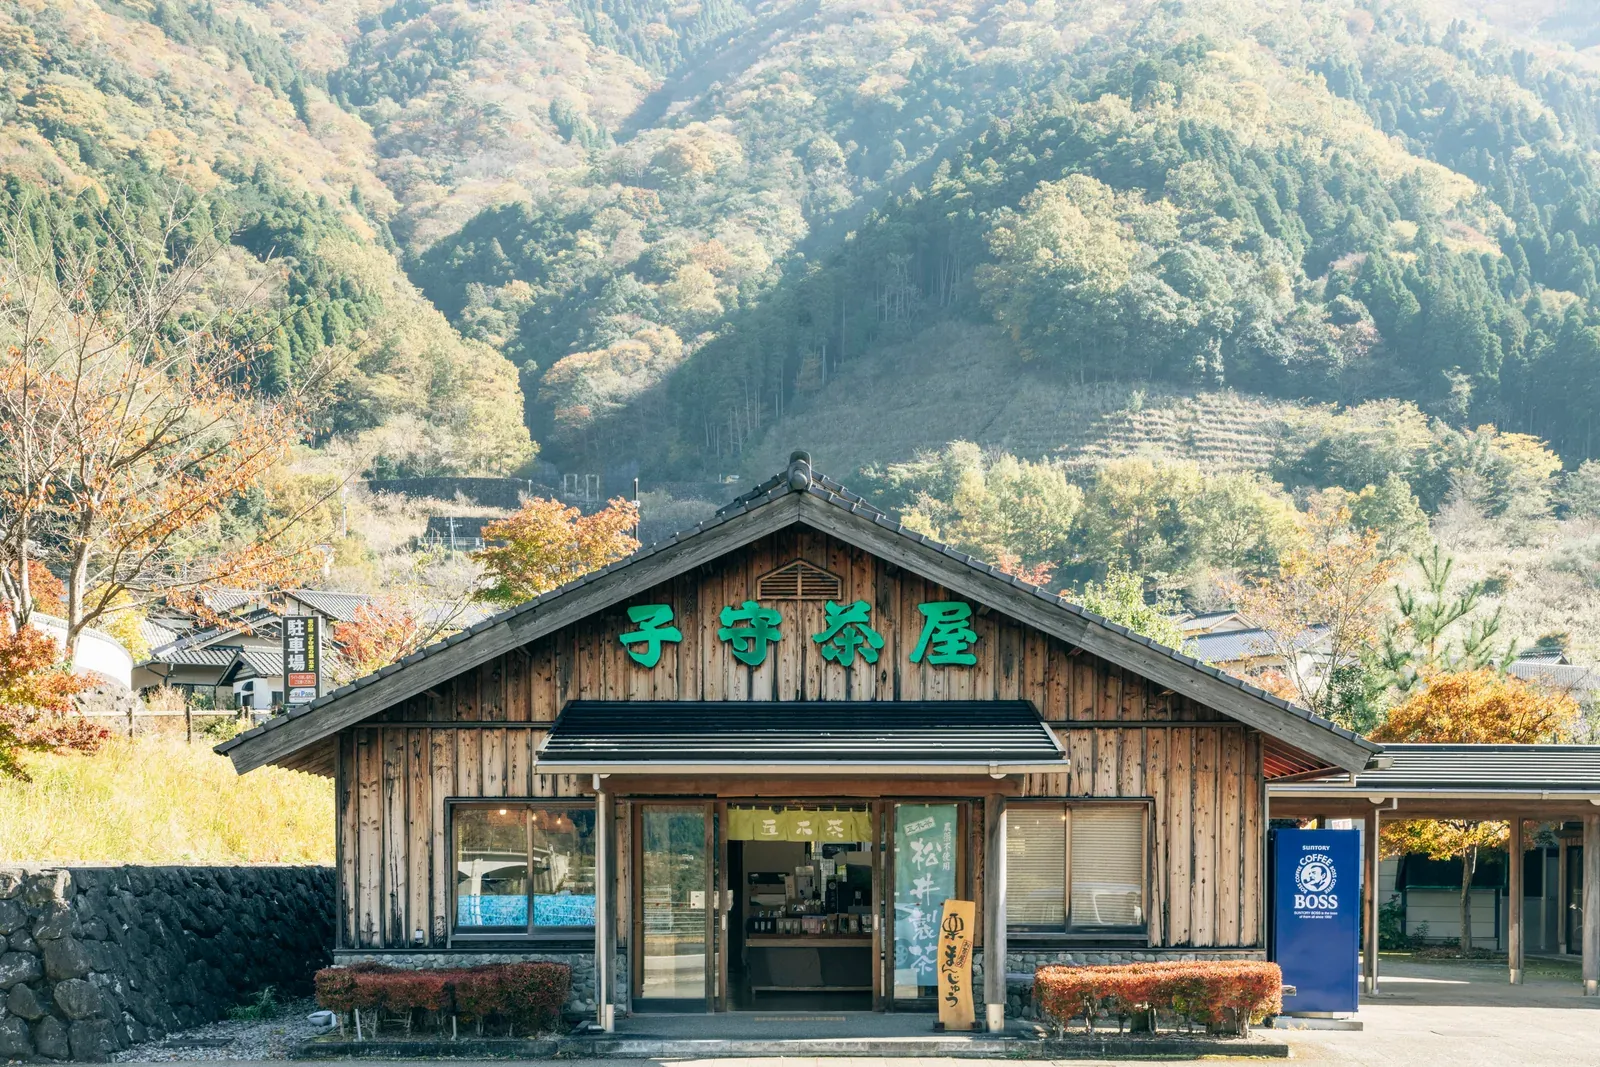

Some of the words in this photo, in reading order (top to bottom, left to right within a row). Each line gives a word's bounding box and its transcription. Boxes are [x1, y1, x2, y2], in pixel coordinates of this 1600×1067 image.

[287, 619, 305, 671] 駐車場
[619, 600, 978, 667] 子守茶屋
[942, 822, 952, 871] 農薬不使用
[1300, 854, 1333, 866] COFFEE
[908, 837, 942, 976] 松井製茶
[1294, 894, 1338, 909] BOSS
